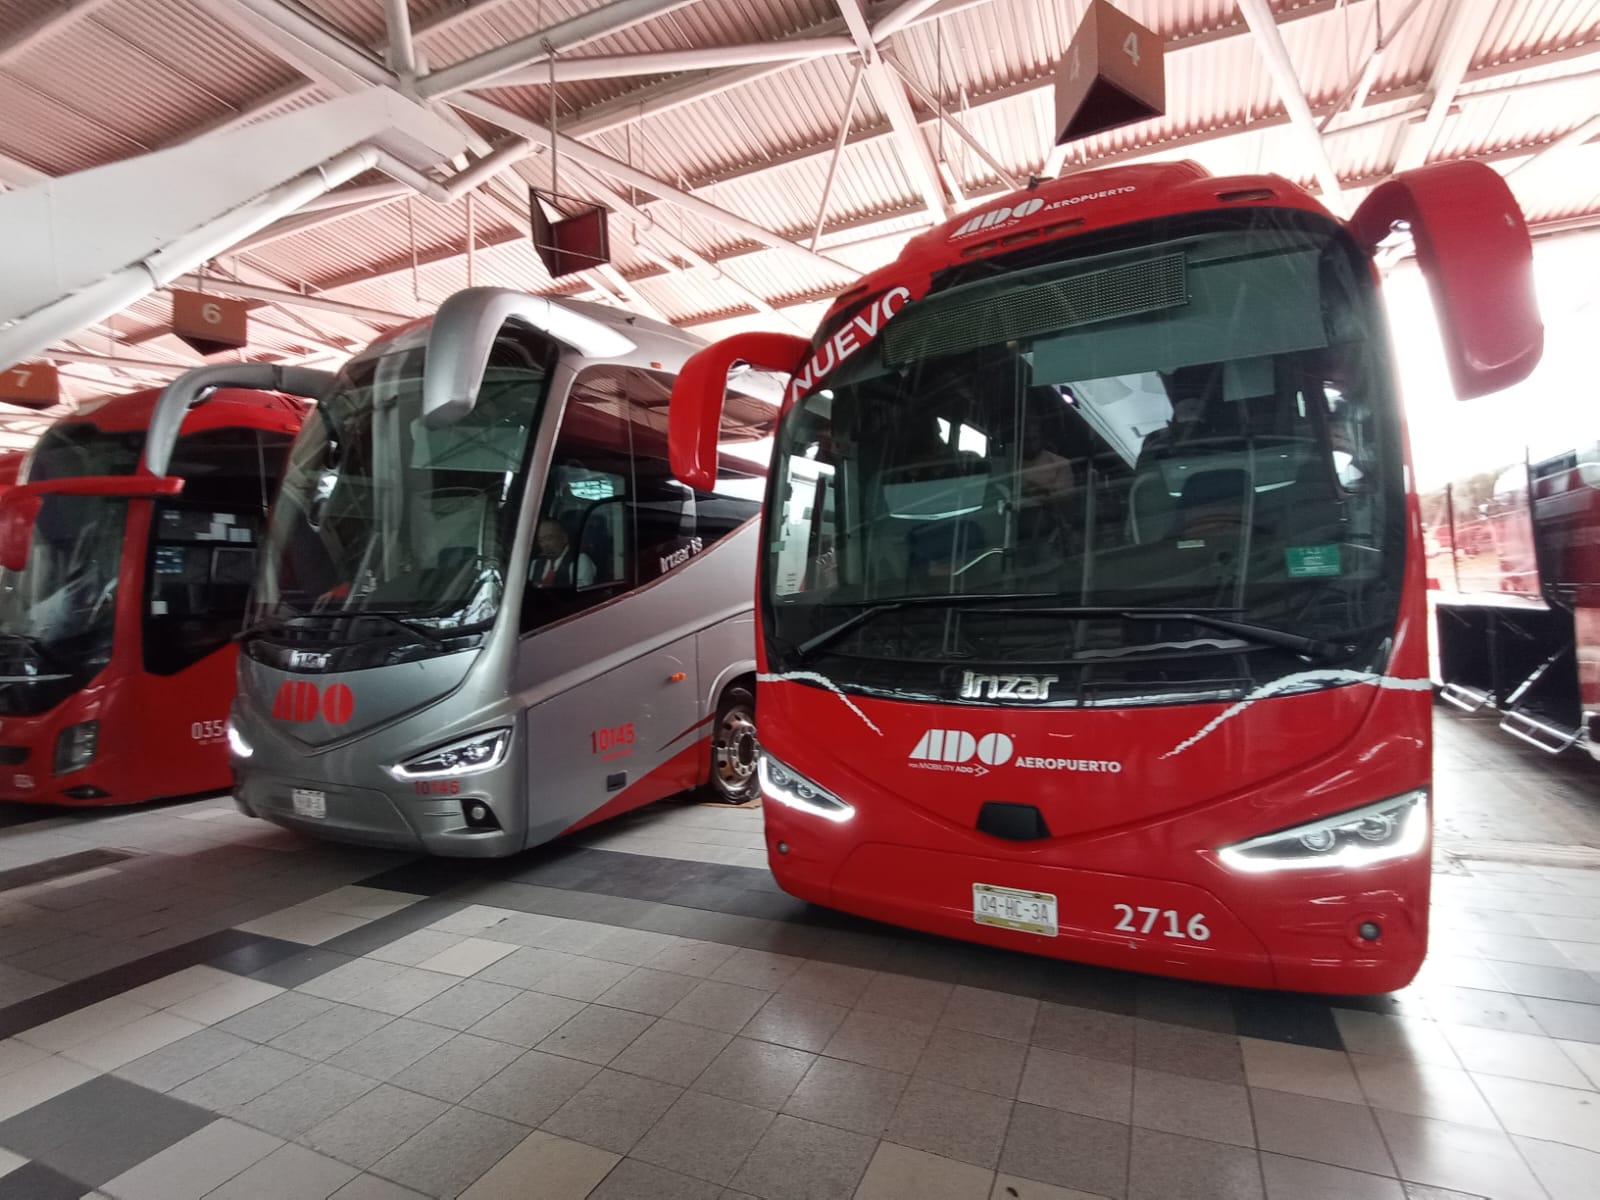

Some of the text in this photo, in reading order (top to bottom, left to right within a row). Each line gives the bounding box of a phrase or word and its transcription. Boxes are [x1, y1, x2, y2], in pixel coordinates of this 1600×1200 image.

[1122, 32, 1140, 67] 4
[950, 199, 1045, 238] ADO
[1043, 186, 1136, 211] AEROPUERTO
[202, 303, 222, 324] 6
[792, 286, 911, 402] NUEVO
[12, 370, 32, 387] 7
[271, 679, 355, 725] ADO
[192, 719, 229, 740] 035
[590, 721, 636, 754] 10145
[908, 729, 1122, 773] ADO AEROPUERTO
[414, 779, 461, 796] 10145
[980, 894, 1050, 923] 04-HC-3A
[1113, 903, 1211, 941] 2716
